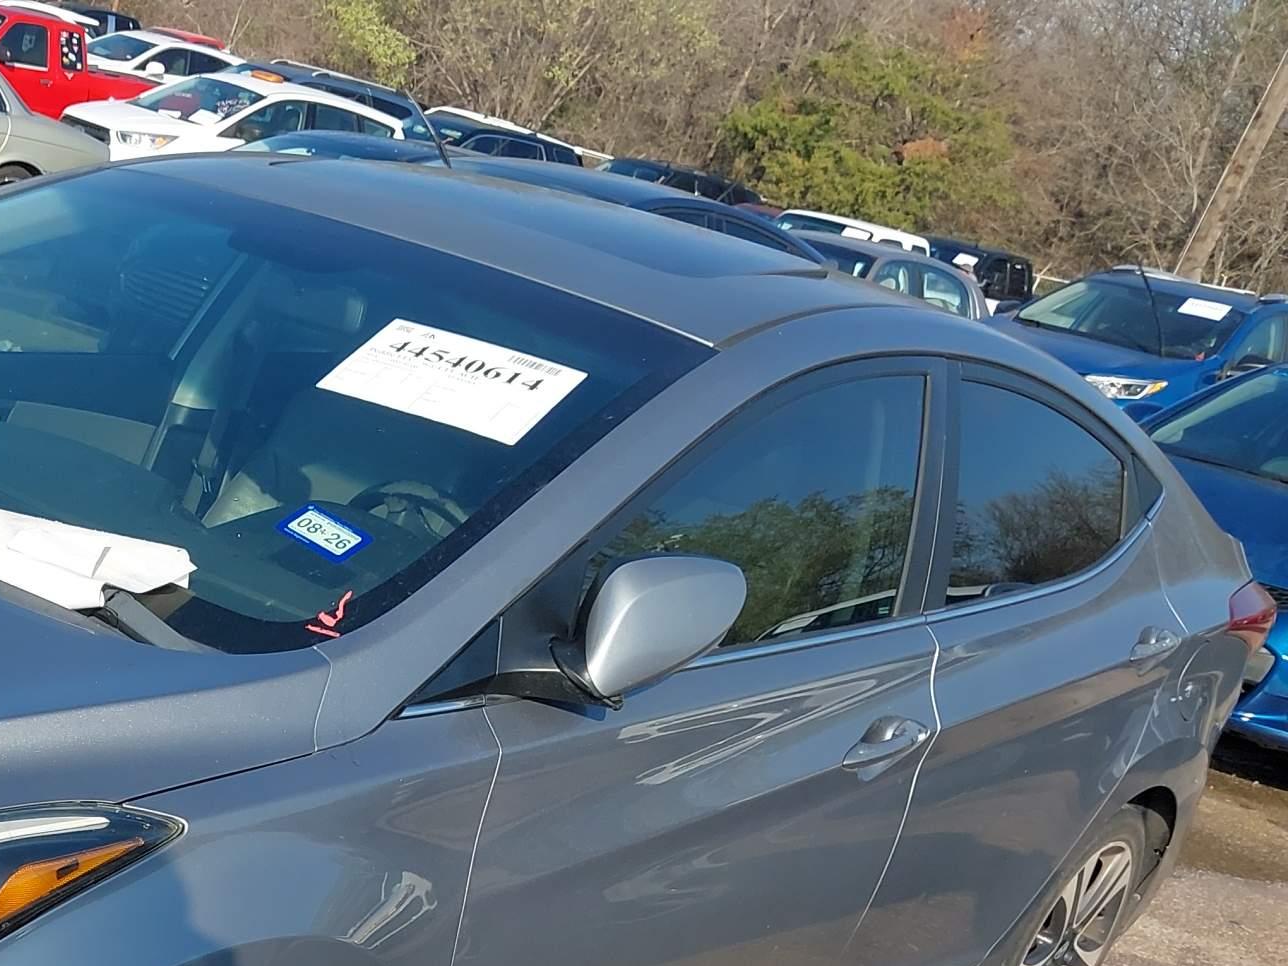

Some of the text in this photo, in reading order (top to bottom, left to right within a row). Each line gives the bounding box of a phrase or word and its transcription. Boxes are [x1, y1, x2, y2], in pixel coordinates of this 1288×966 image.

[388, 340, 545, 392] 44540614
[296, 517, 322, 534] 08
[323, 532, 352, 550] 26
